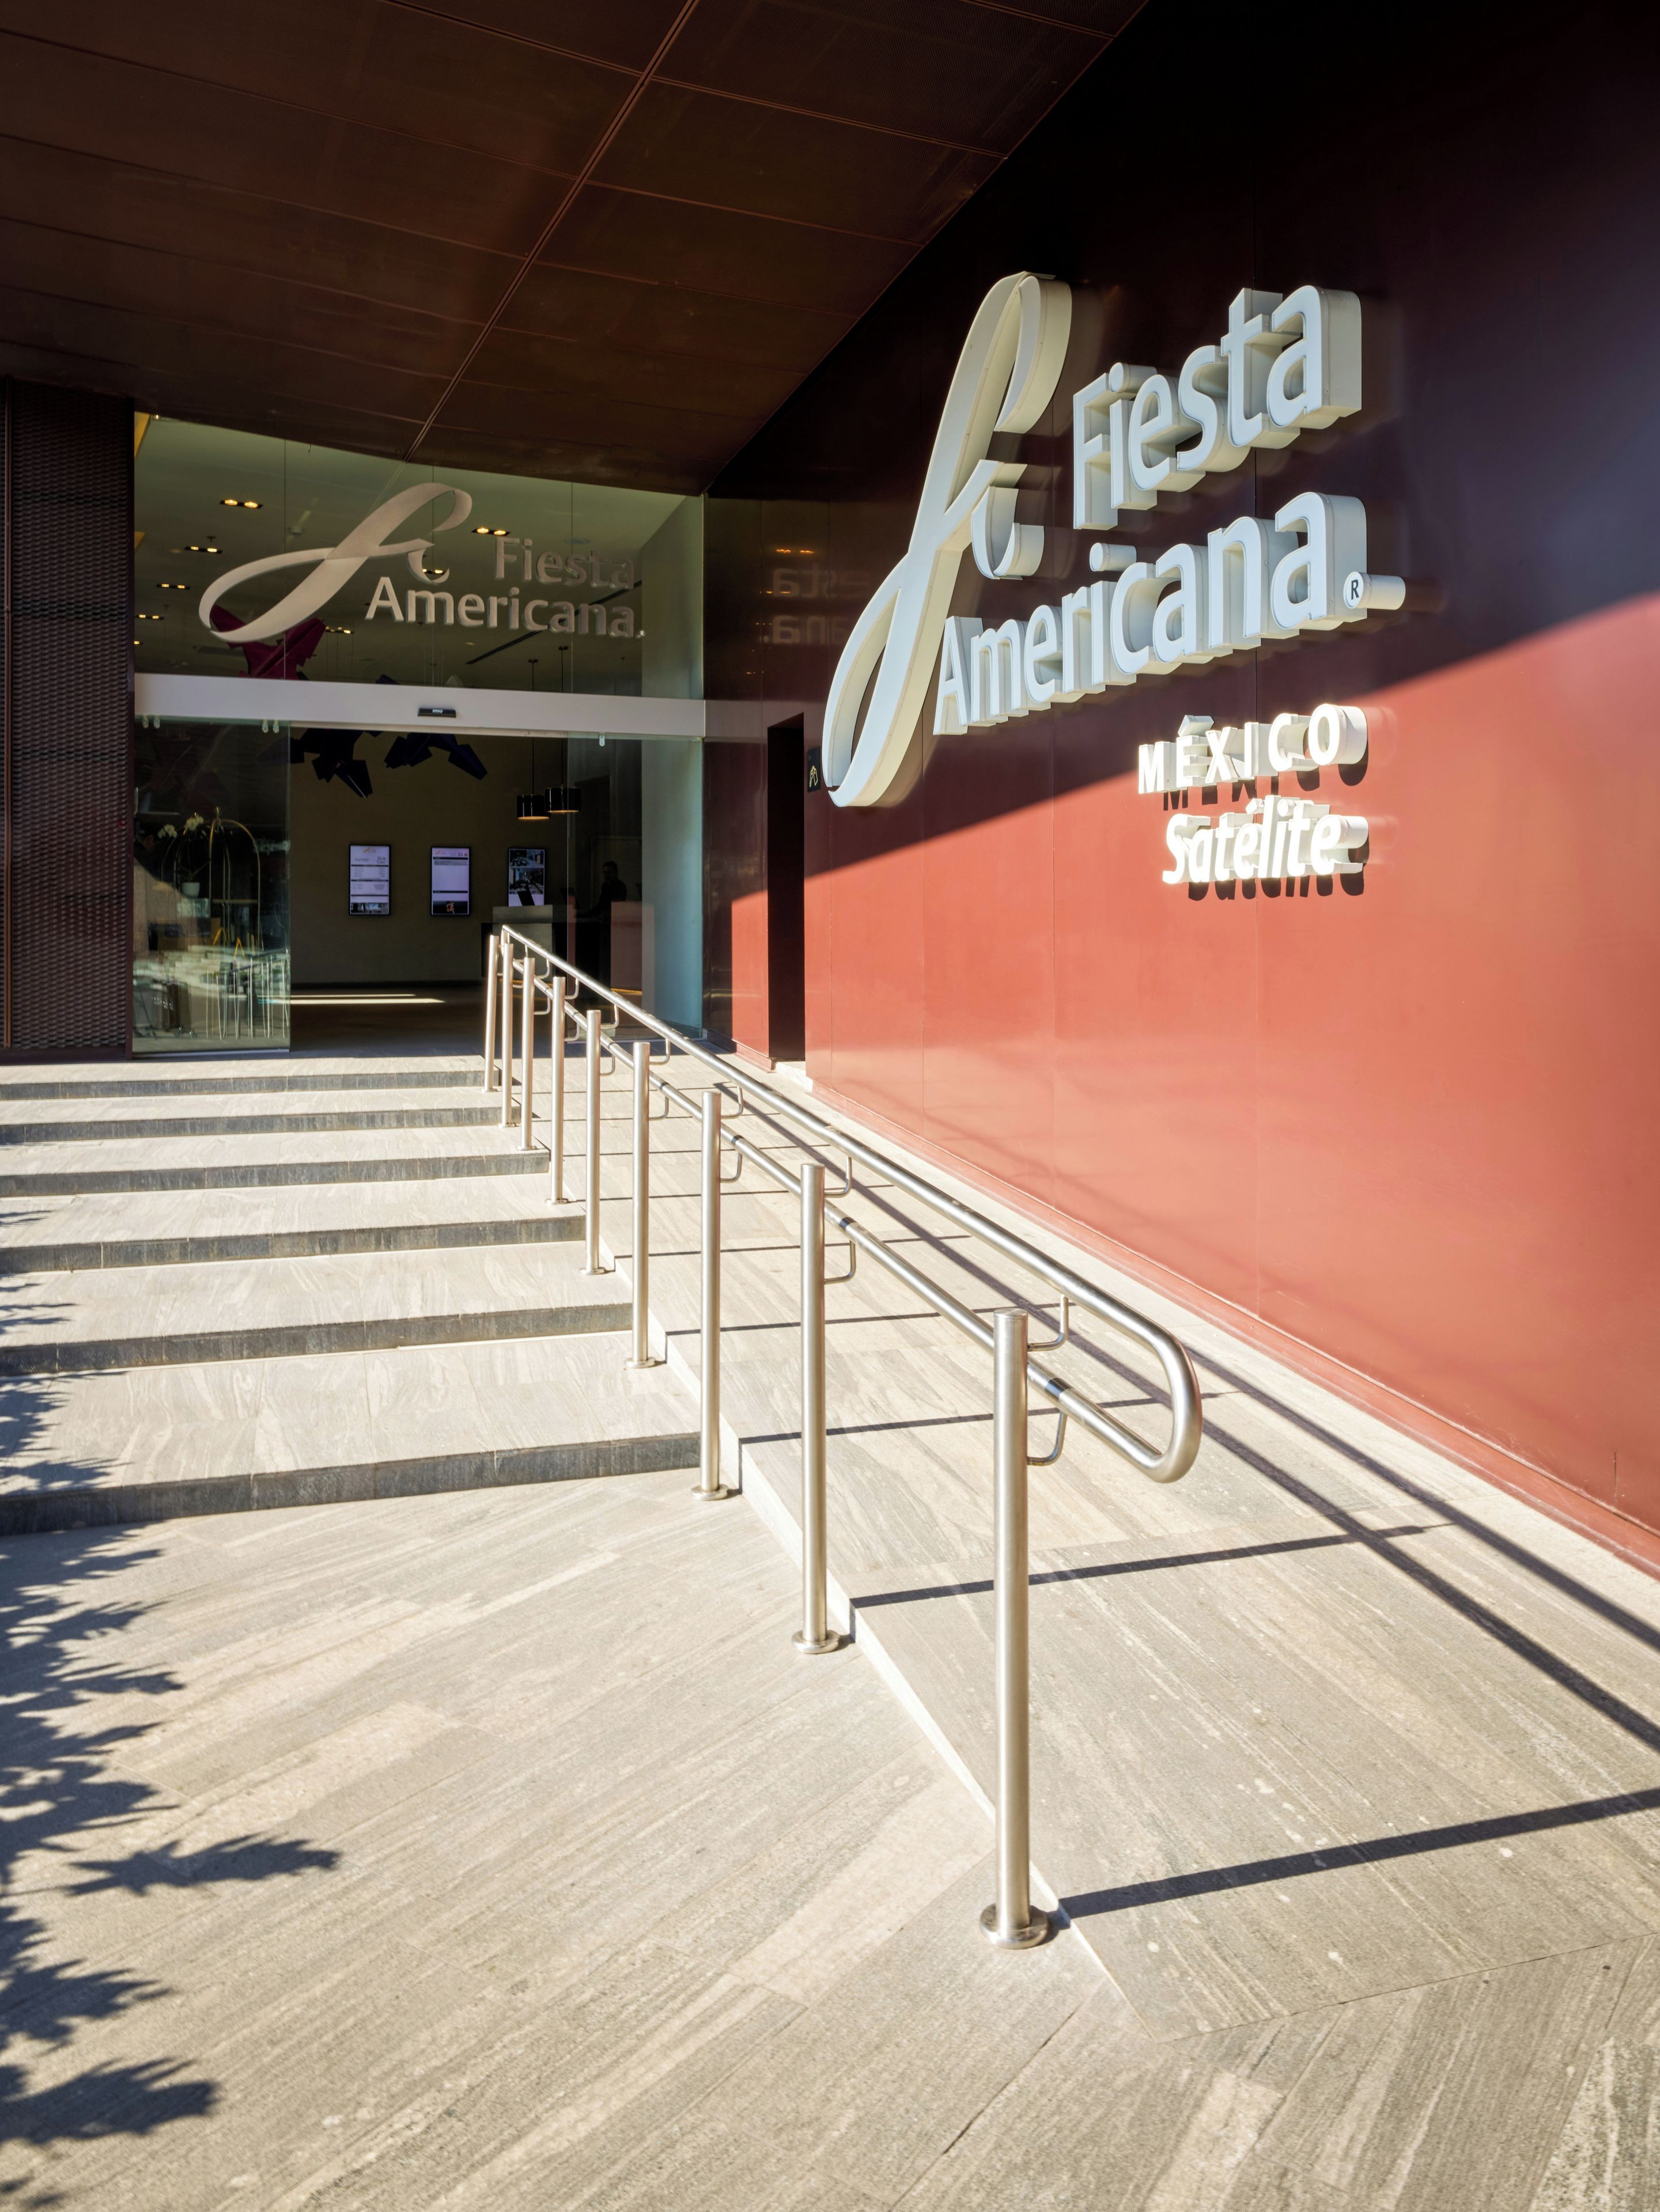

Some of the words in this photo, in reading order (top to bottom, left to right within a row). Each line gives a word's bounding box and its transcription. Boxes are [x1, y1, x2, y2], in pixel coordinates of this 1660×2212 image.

[1073, 285, 1345, 530] Fiesta
[494, 536, 634, 590] Fiesta
[1162, 795, 1354, 884] Satélite
